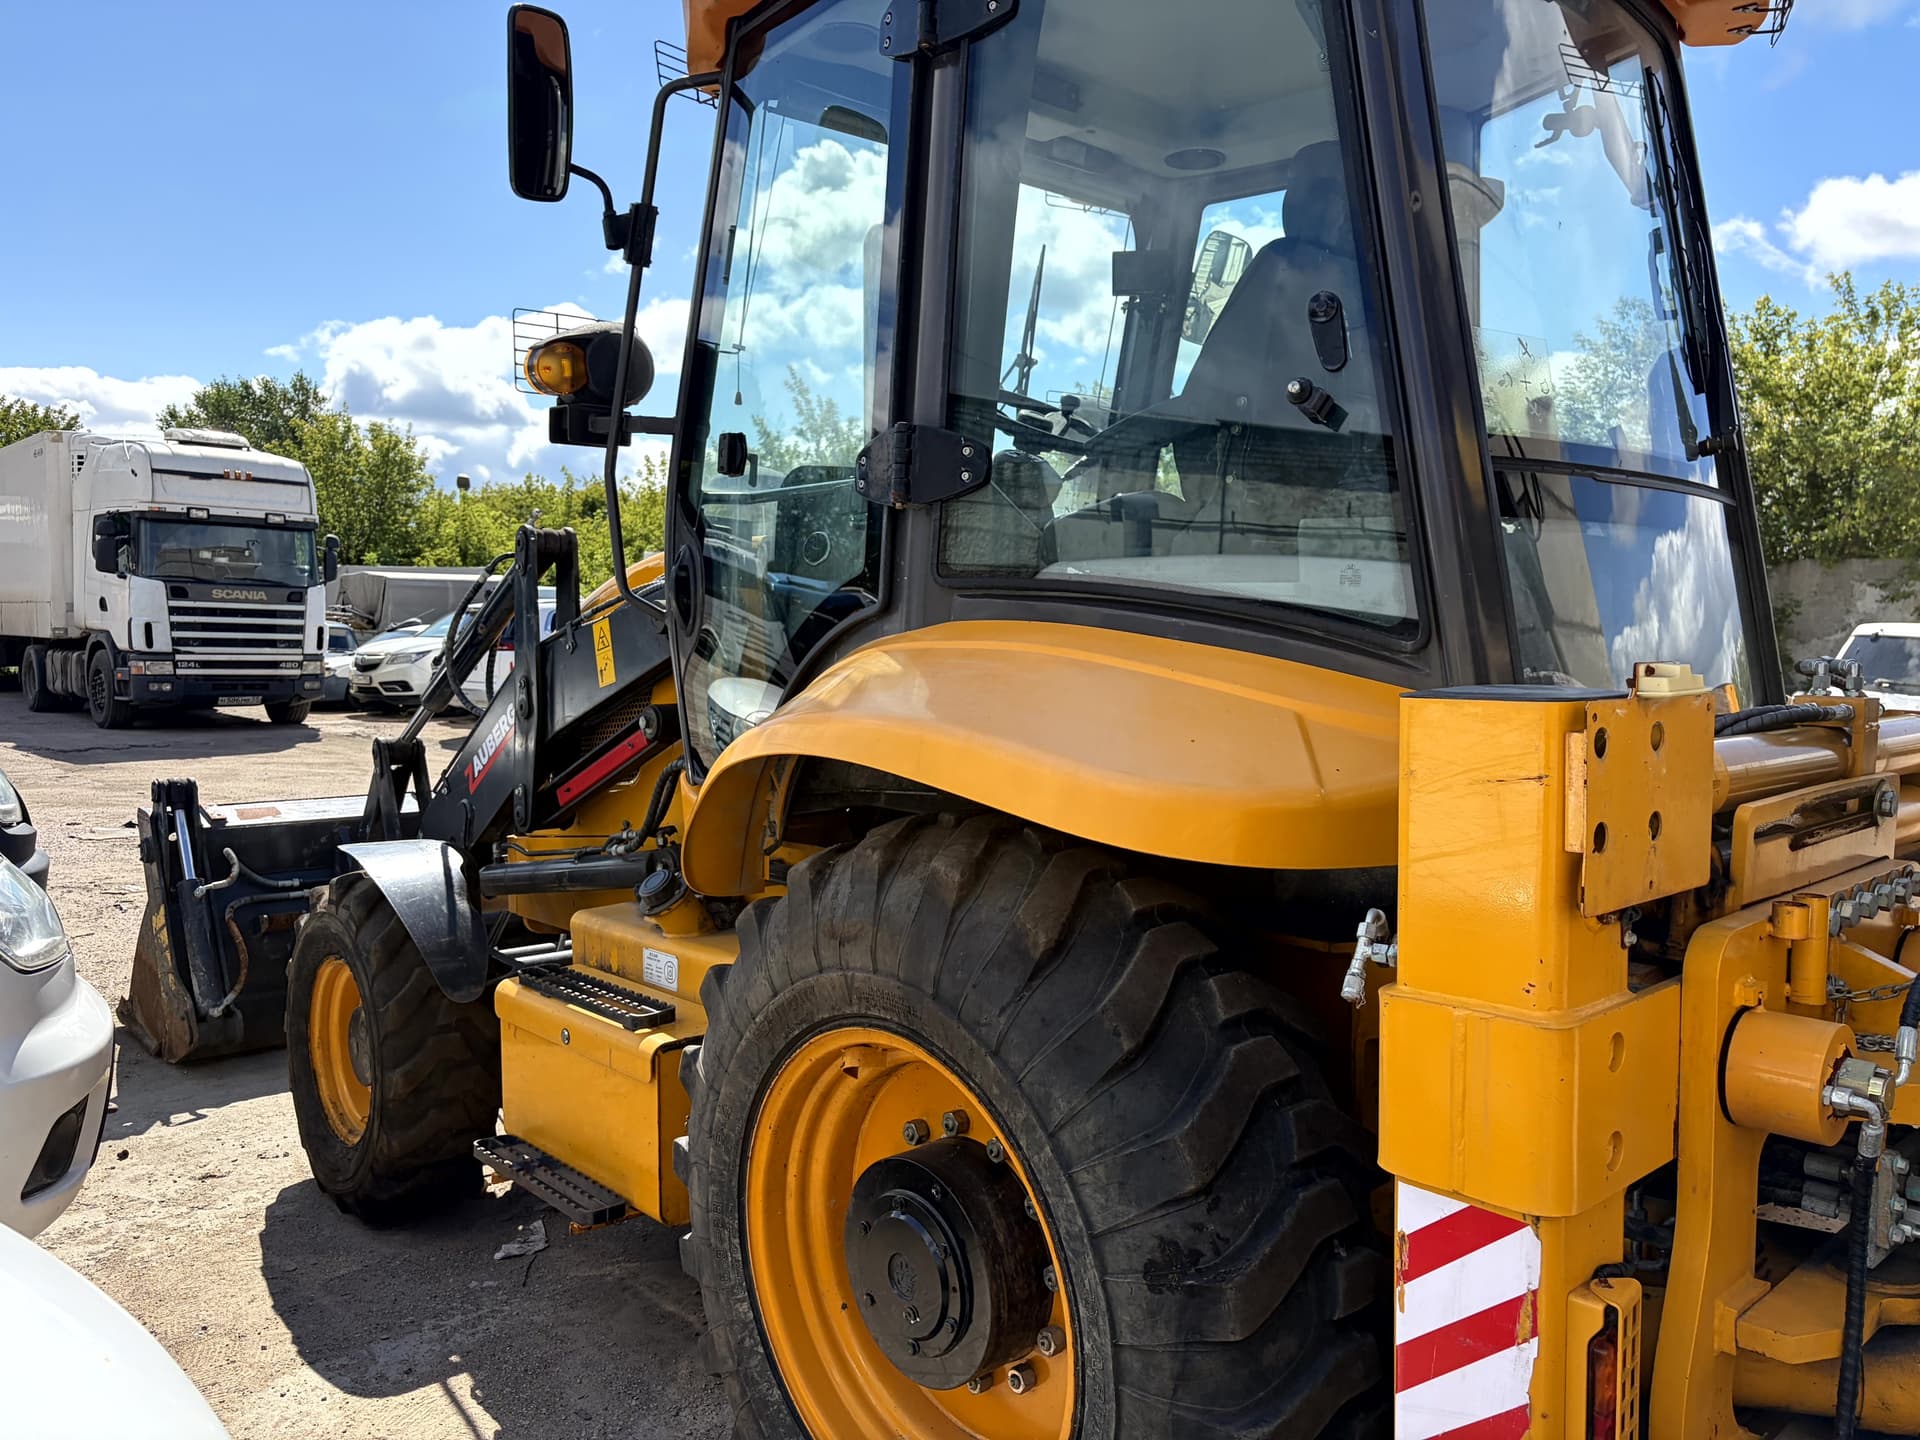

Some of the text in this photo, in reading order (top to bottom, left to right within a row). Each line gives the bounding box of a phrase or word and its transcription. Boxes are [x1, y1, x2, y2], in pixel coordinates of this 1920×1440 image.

[211, 588, 268, 601] SCANIA
[279, 661, 299, 669] 420
[464, 702, 516, 795] ZAUBERG
